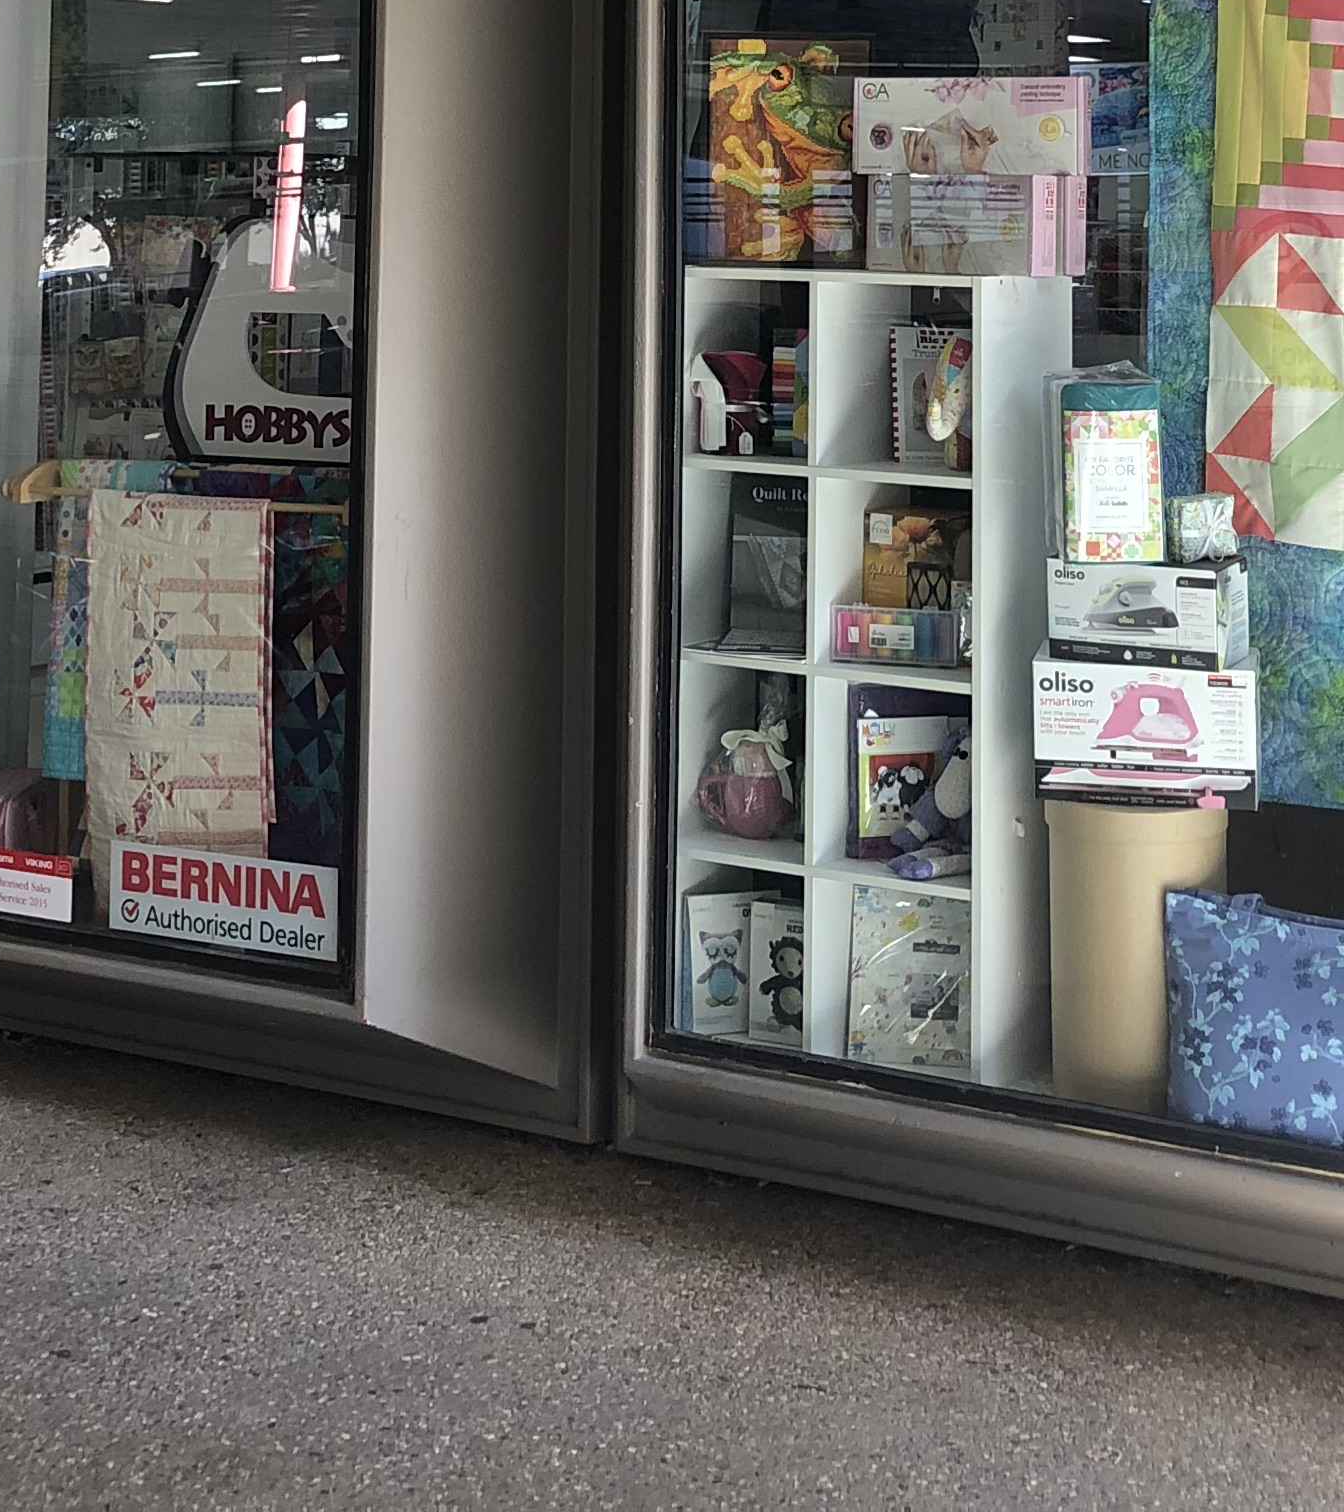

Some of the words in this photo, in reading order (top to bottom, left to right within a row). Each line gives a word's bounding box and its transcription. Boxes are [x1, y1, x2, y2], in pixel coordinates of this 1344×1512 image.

[1099, 154, 1122, 169] ME
[205, 404, 351, 448] HOBBYS
[752, 487, 787, 502] Quilt
[1054, 566, 1085, 580] oliso
[1039, 671, 1095, 693] oliso
[24, 858, 53, 869] VIKING
[31, 882, 52, 894] Sales
[121, 850, 326, 919] BERNINA
[29, 897, 47, 908] 2015
[144, 905, 253, 941] Authorised
[259, 921, 326, 951] Dealer
